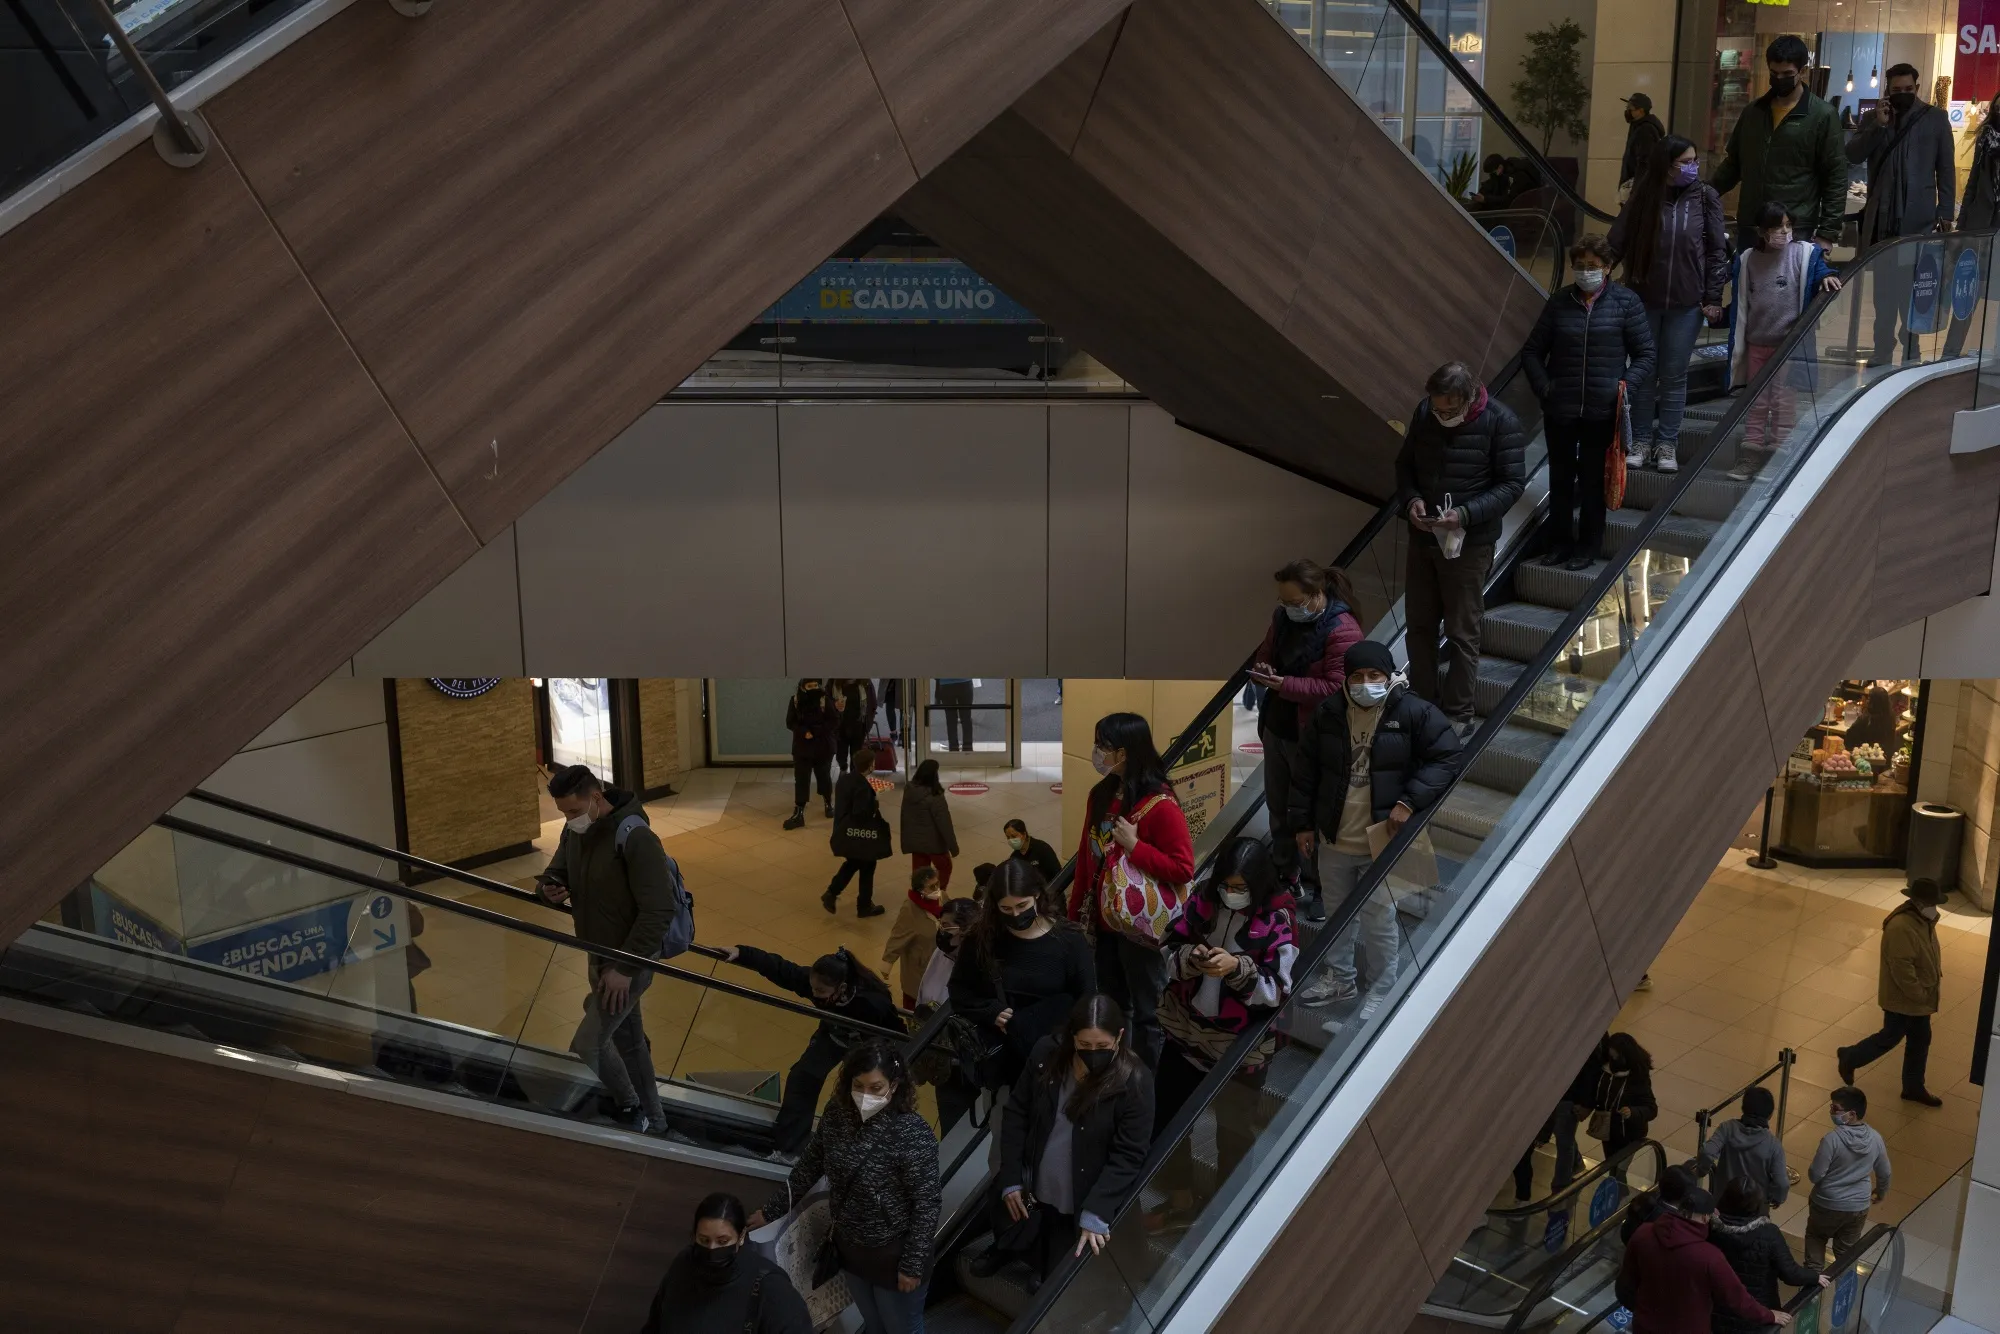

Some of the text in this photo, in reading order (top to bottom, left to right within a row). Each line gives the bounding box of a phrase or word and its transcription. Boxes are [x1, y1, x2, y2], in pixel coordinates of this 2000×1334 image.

[1959, 24, 2000, 54] SA
[820, 274, 993, 286] ESTA CELEBRACIÓN E
[934, 289, 995, 310] UNO
[451, 679, 467, 690] DEL
[846, 827, 878, 839] SR665
[221, 924, 325, 967] ¿BUSCAS UNA
